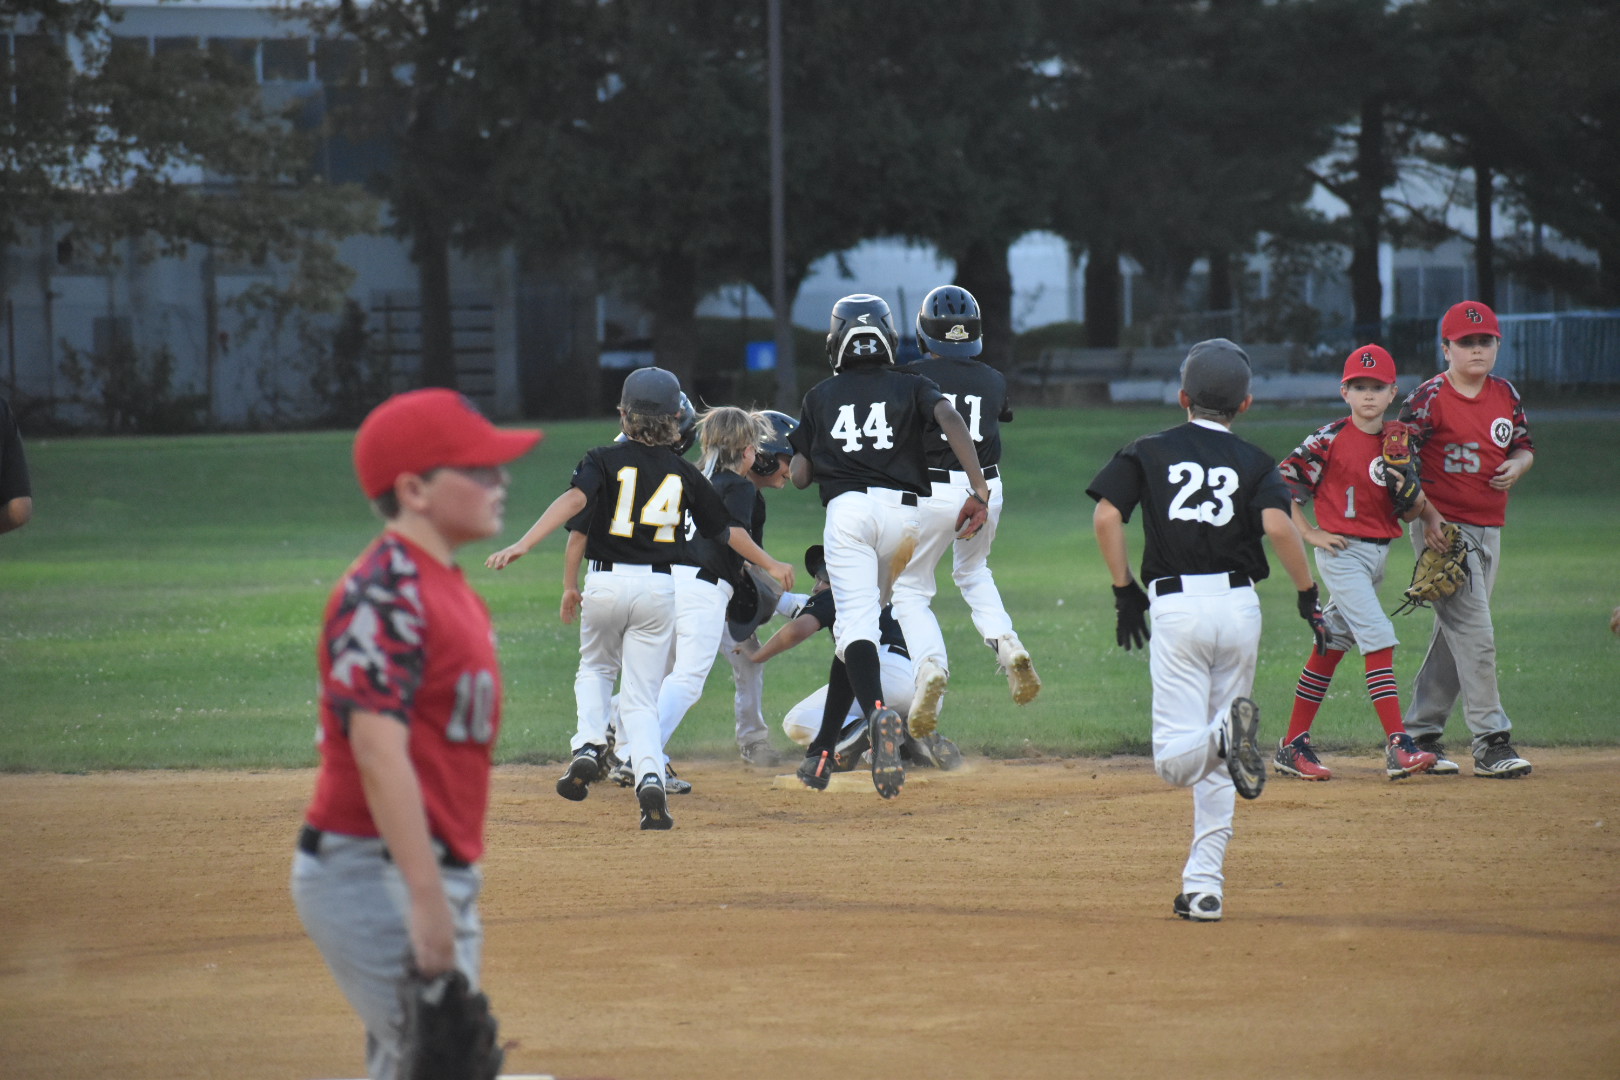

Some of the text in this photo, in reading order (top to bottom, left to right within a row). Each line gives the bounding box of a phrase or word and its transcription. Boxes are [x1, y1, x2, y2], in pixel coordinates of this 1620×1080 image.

[831, 402, 894, 452] 44
[1443, 442, 1481, 474] 25
[609, 466, 684, 543] 14
[1168, 461, 1239, 527] 23
[1345, 486, 1356, 518] 1
